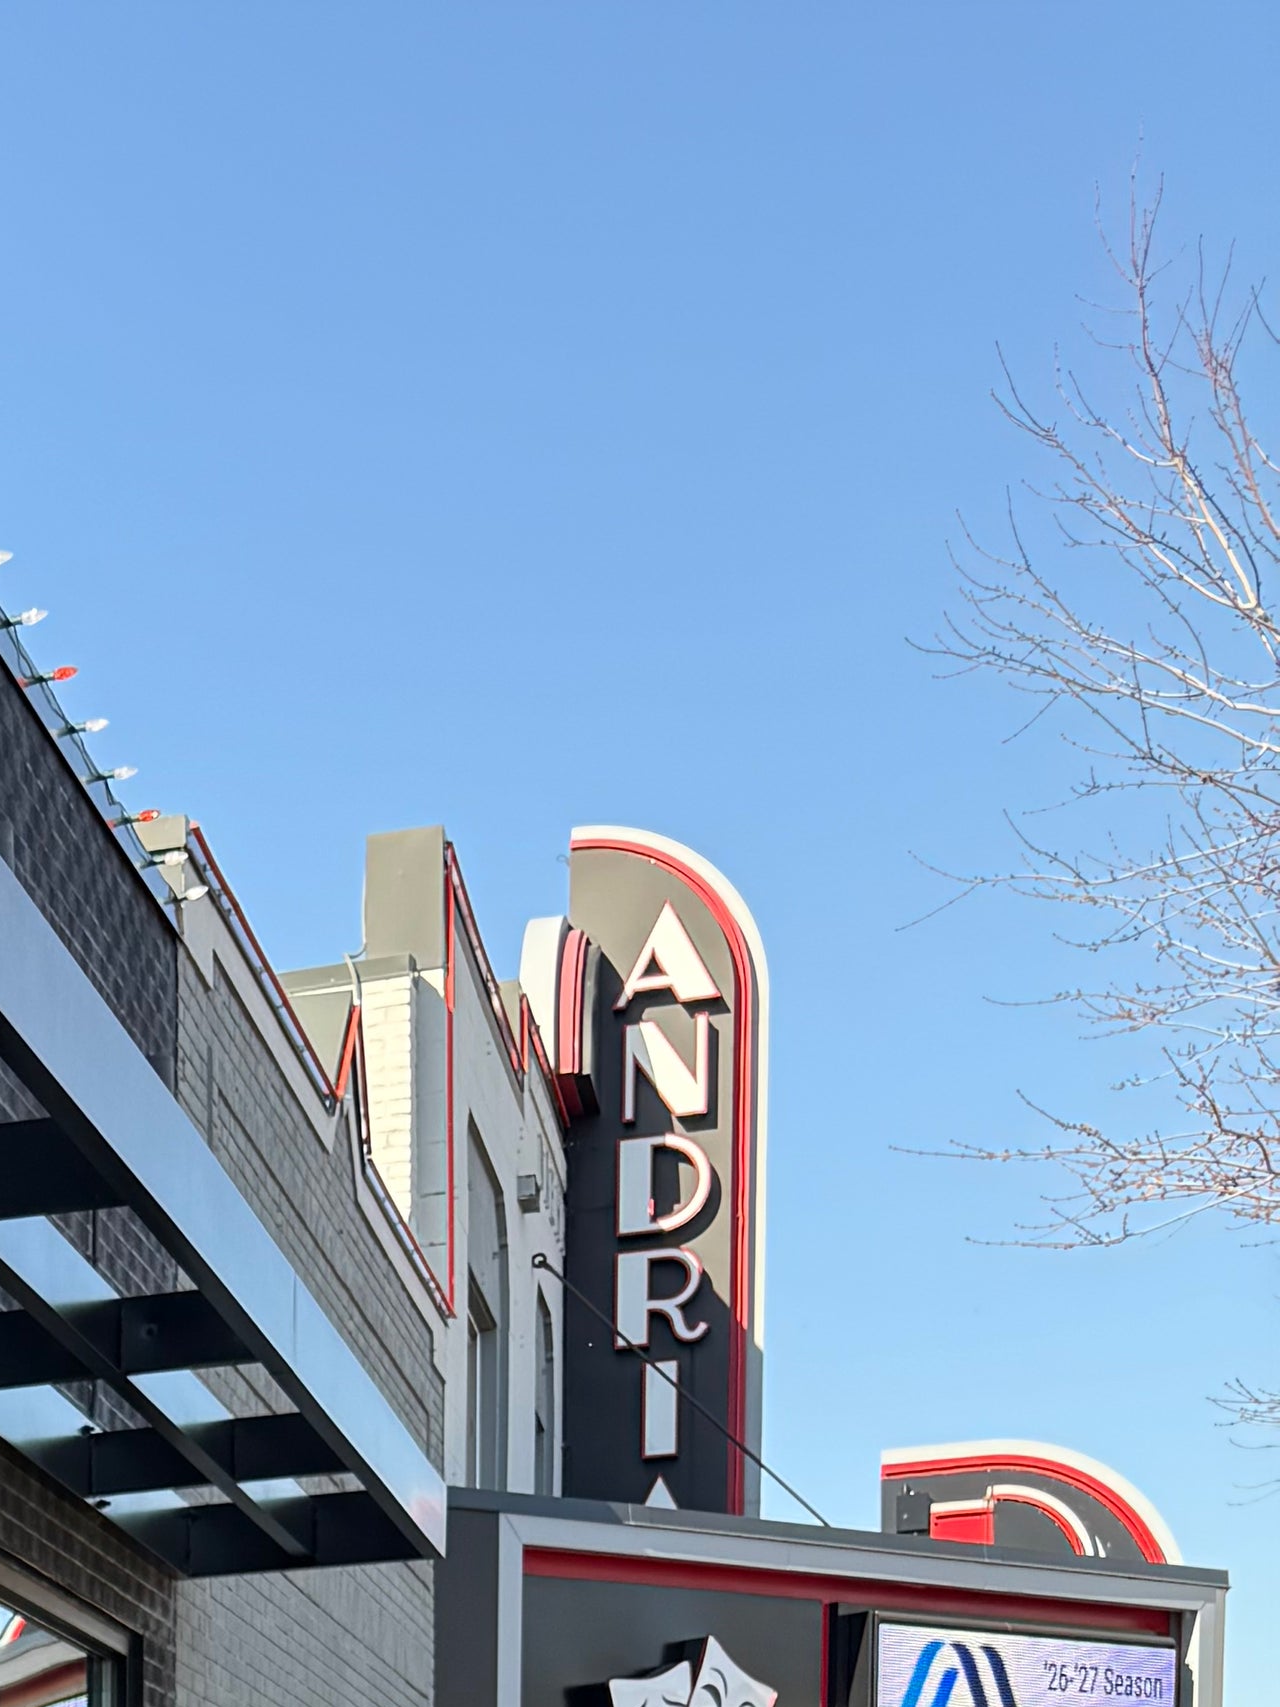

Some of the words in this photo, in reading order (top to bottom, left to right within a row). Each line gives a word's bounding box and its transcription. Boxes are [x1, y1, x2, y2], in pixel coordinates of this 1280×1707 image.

[612, 898, 722, 1511] ANDRI
[1043, 1660, 1098, 1695] '26-'27
[1103, 1667, 1163, 1700] Season
